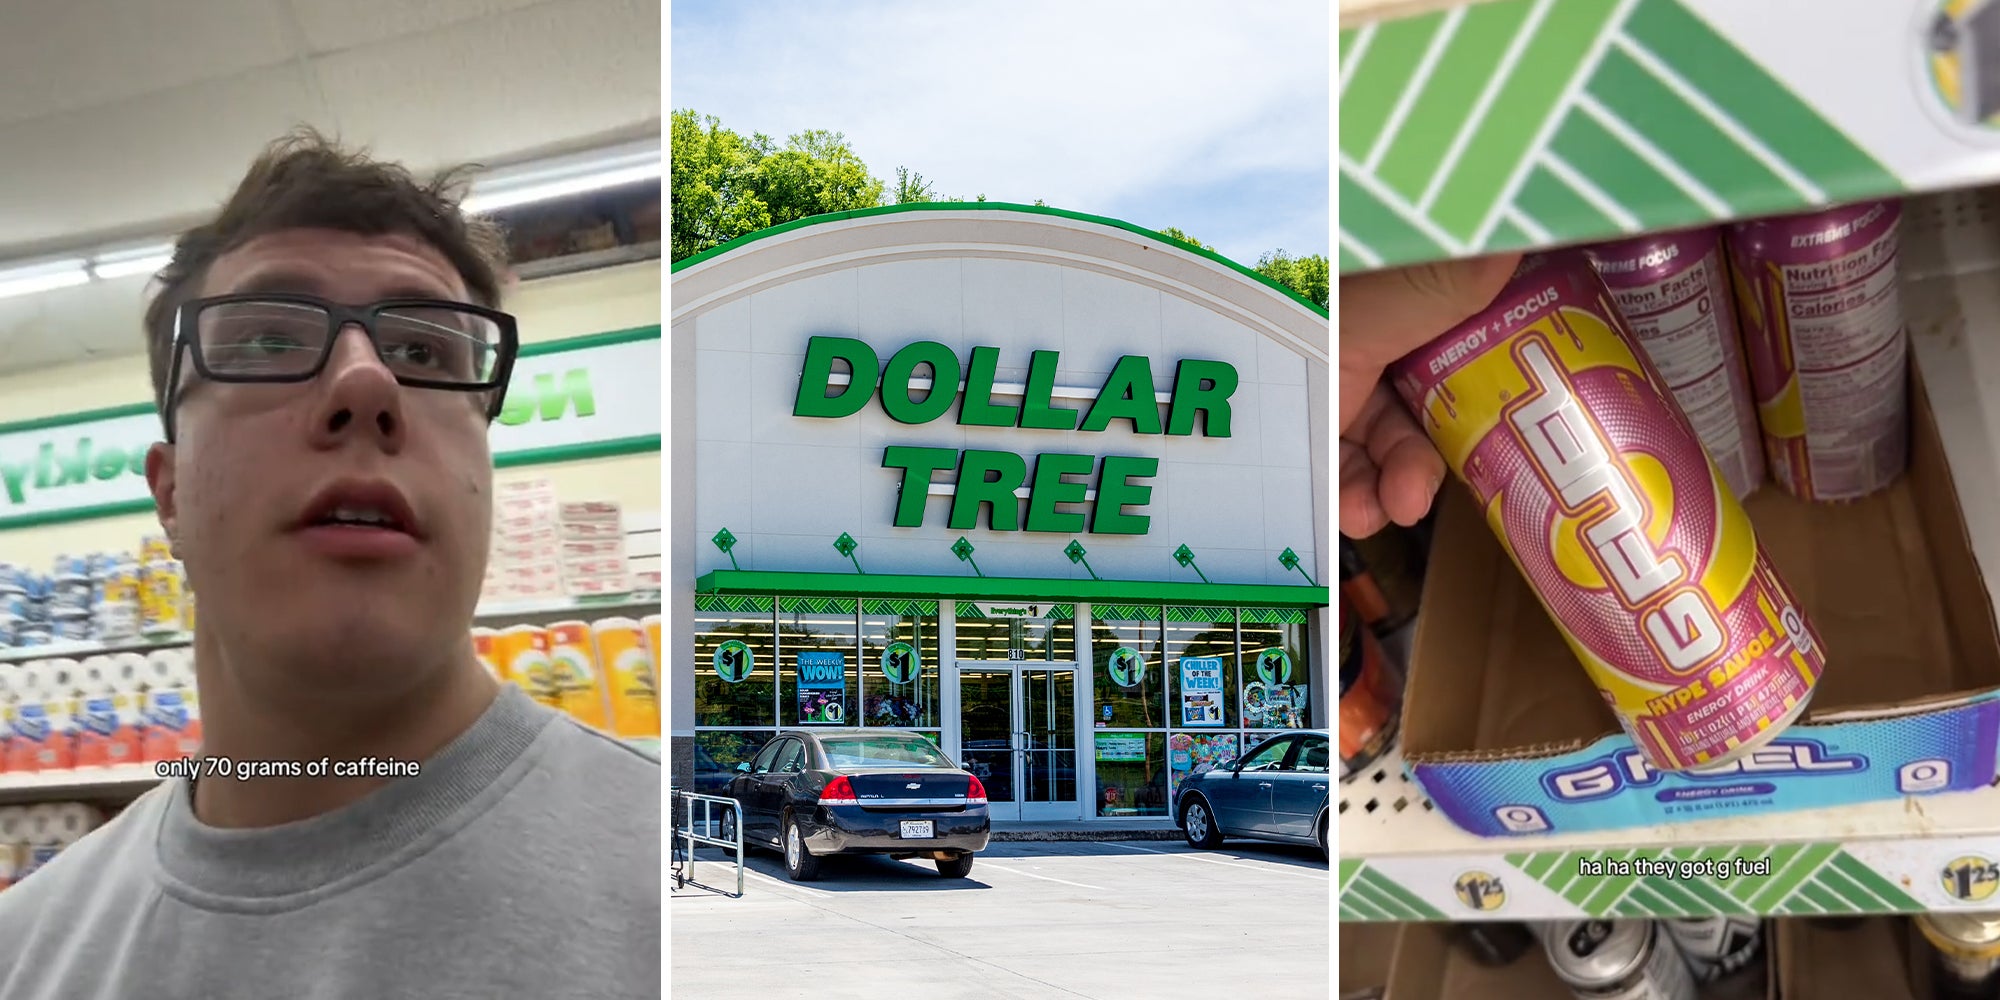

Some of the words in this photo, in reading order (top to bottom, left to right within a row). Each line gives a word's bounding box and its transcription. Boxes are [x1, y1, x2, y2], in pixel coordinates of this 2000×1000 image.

[1790, 223, 1851, 249] EXTREME
[1592, 258, 1636, 274] TREME
[1639, 244, 1680, 270] FOCUS
[1786, 255, 1868, 282] Nutrition
[1660, 267, 1703, 297] Facts
[1697, 296, 1711, 314] 0
[1791, 293, 1867, 317] Calories
[1429, 325, 1488, 376] ENERGY
[1503, 286, 1560, 328] FOCUS
[793, 335, 1239, 439] DOLLAR
[881, 445, 1159, 535] TREE
[990, 607, 1027, 616] Everything's
[1028, 605, 1038, 617] $1
[1785, 611, 1801, 636] 0
[722, 649, 744, 682] $1
[801, 658, 814, 666] THE
[817, 658, 843, 666] WEEKLY
[889, 650, 911, 683] $1
[1008, 649, 1024, 659] 810
[1185, 660, 1218, 671] CHILLER
[801, 665, 843, 682] WOW!
[1116, 654, 1137, 686] $1
[1185, 677, 1218, 689] WEEK!
[1263, 654, 1285, 685] $1
[1646, 680, 1708, 718] HYPE
[1708, 629, 1776, 689] SAUCE
[1687, 690, 1734, 725] ENERGY
[1734, 665, 1770, 698] DRINK
[1680, 734, 1710, 756] CONTAINS
[1709, 726, 1738, 746] NATURAL
[1737, 714, 1754, 731] AND
[1749, 695, 1780, 722] ARTIFICIAL
[1709, 718, 1723, 734] OZ
[1556, 765, 1616, 799] G
[1625, 745, 1855, 783] FEL
[1674, 786, 1719, 799] ENERGY
[1720, 784, 1756, 796] DRINK
